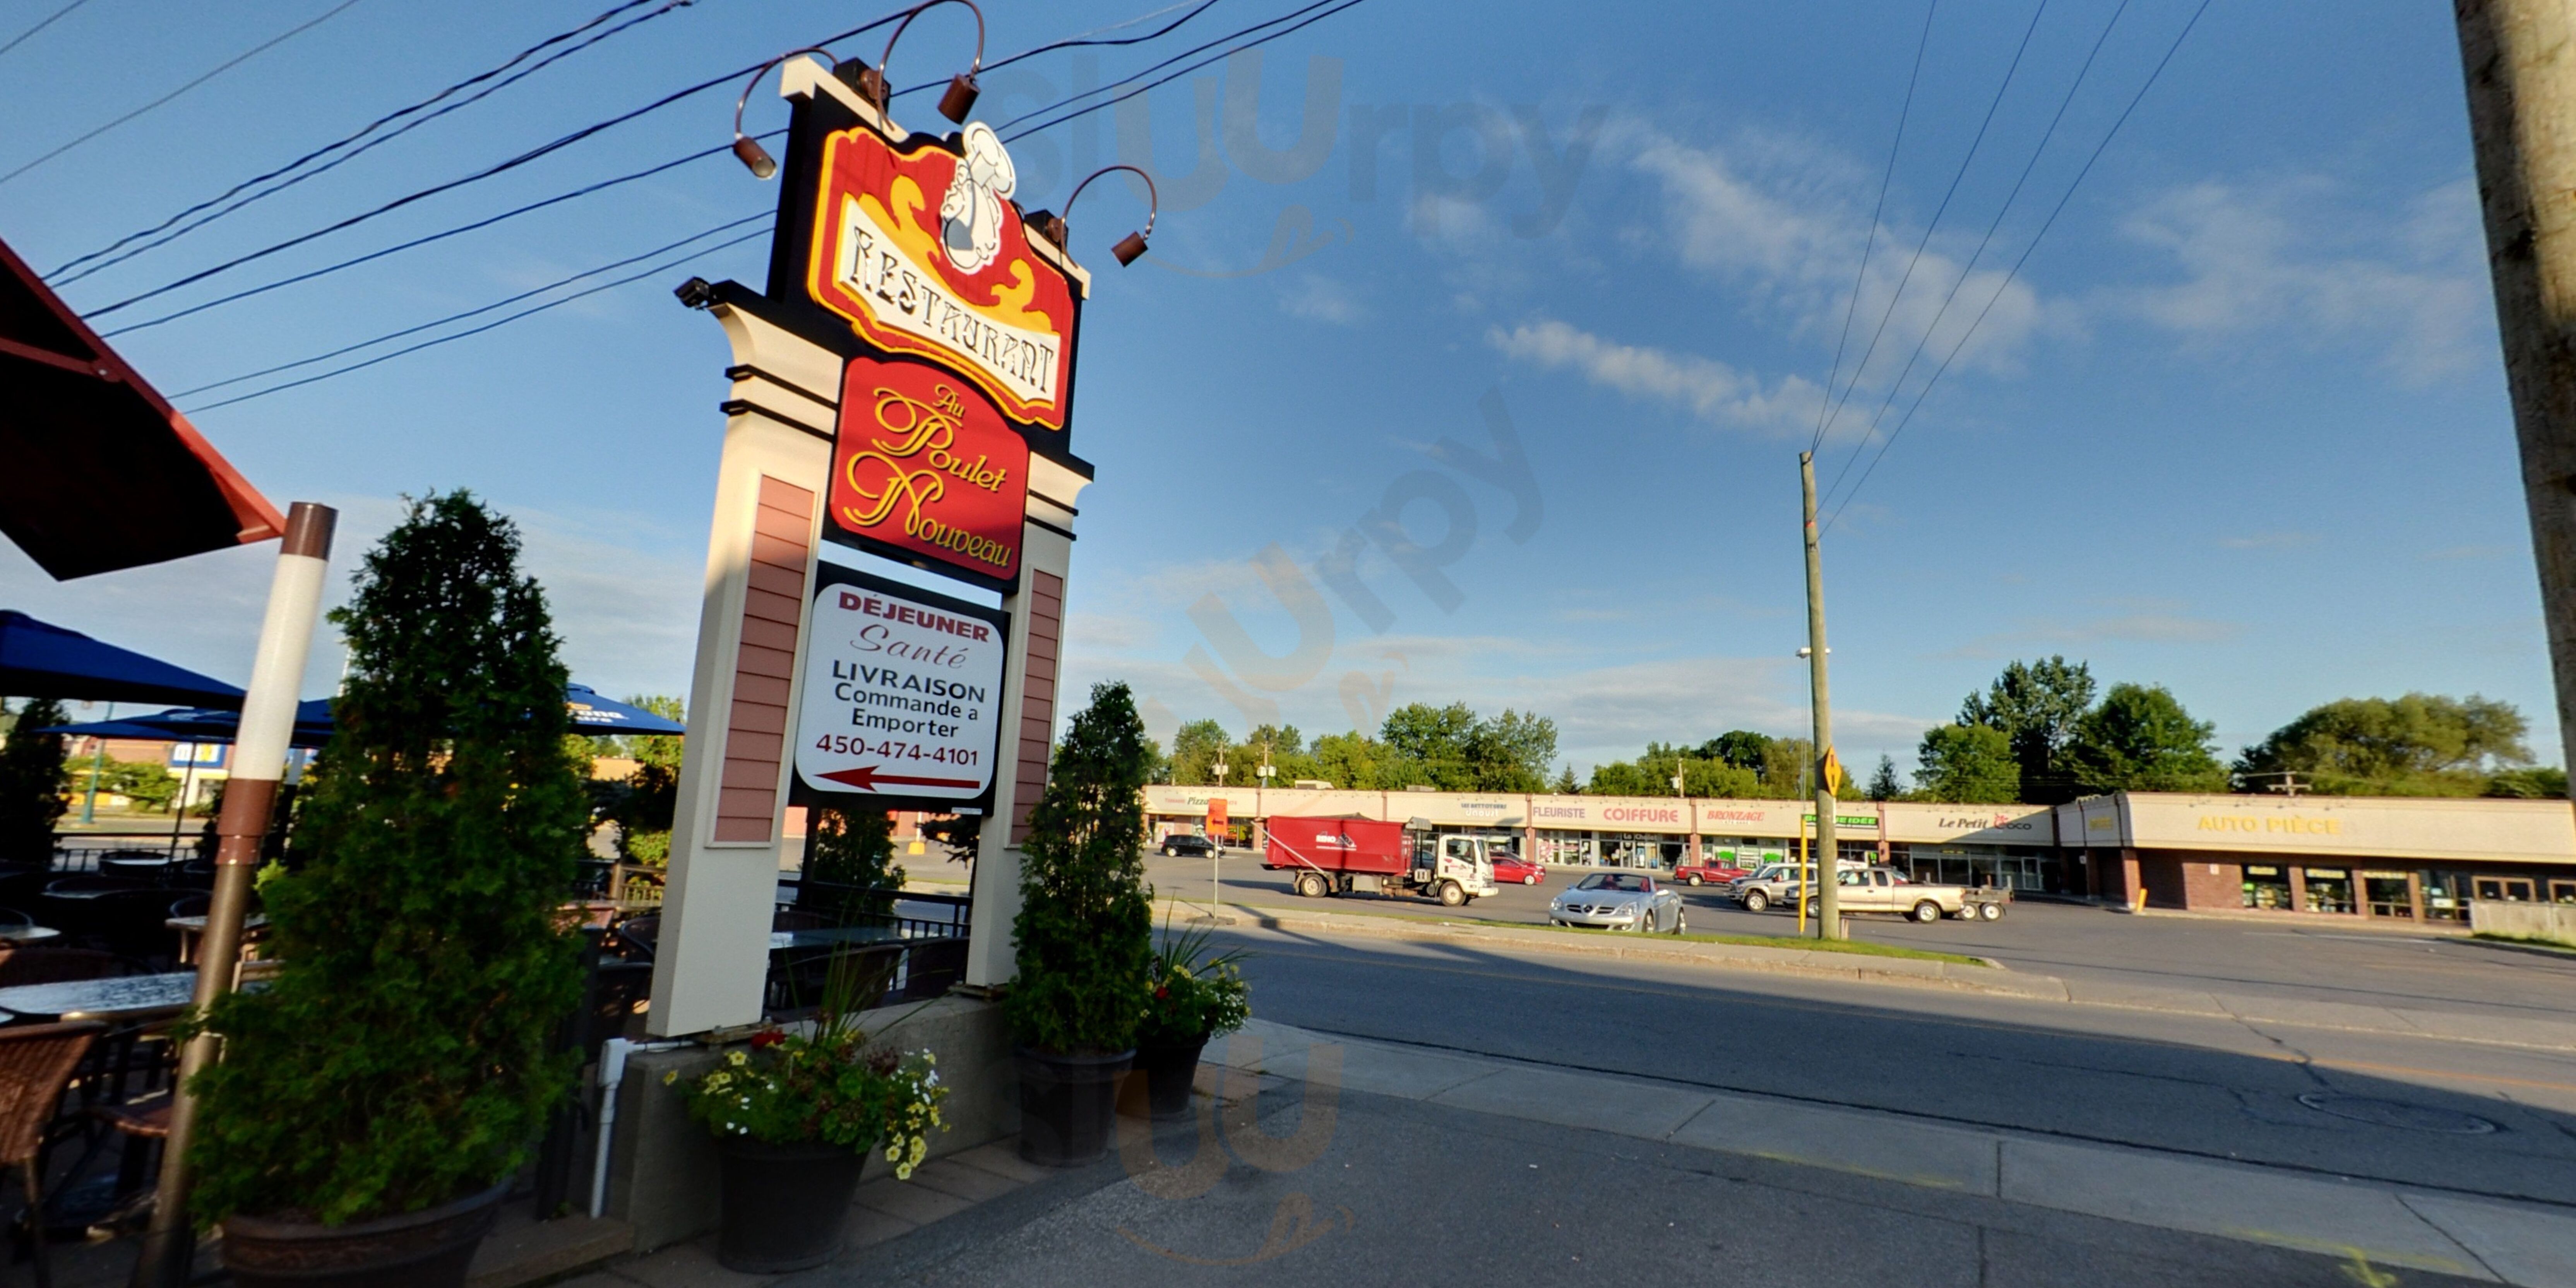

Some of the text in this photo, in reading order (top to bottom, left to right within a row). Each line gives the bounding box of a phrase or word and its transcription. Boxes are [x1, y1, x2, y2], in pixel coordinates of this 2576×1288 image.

[850, 226, 1055, 393] RESTAURANT
[933, 384, 965, 417] Au
[872, 387, 1007, 492] Poulet
[843, 450, 1011, 567] Nouveau
[839, 591, 990, 642] DÉJEUNER
[850, 624, 969, 669] Santé
[832, 660, 985, 703] LIVRAISON
[835, 682, 978, 720] Commande a
[852, 708, 959, 737] Emporter
[816, 734, 978, 766] 450-474-4101
[1533, 807, 1586, 819] FLEURISTE
[1603, 808, 1679, 822] COIFFURE
[1707, 810, 1765, 821] BRONZAGE
[1939, 817, 1954, 828] Le
[1957, 818, 1988, 828] Petit
[2198, 814, 2341, 835] AUTO PIÈCE
